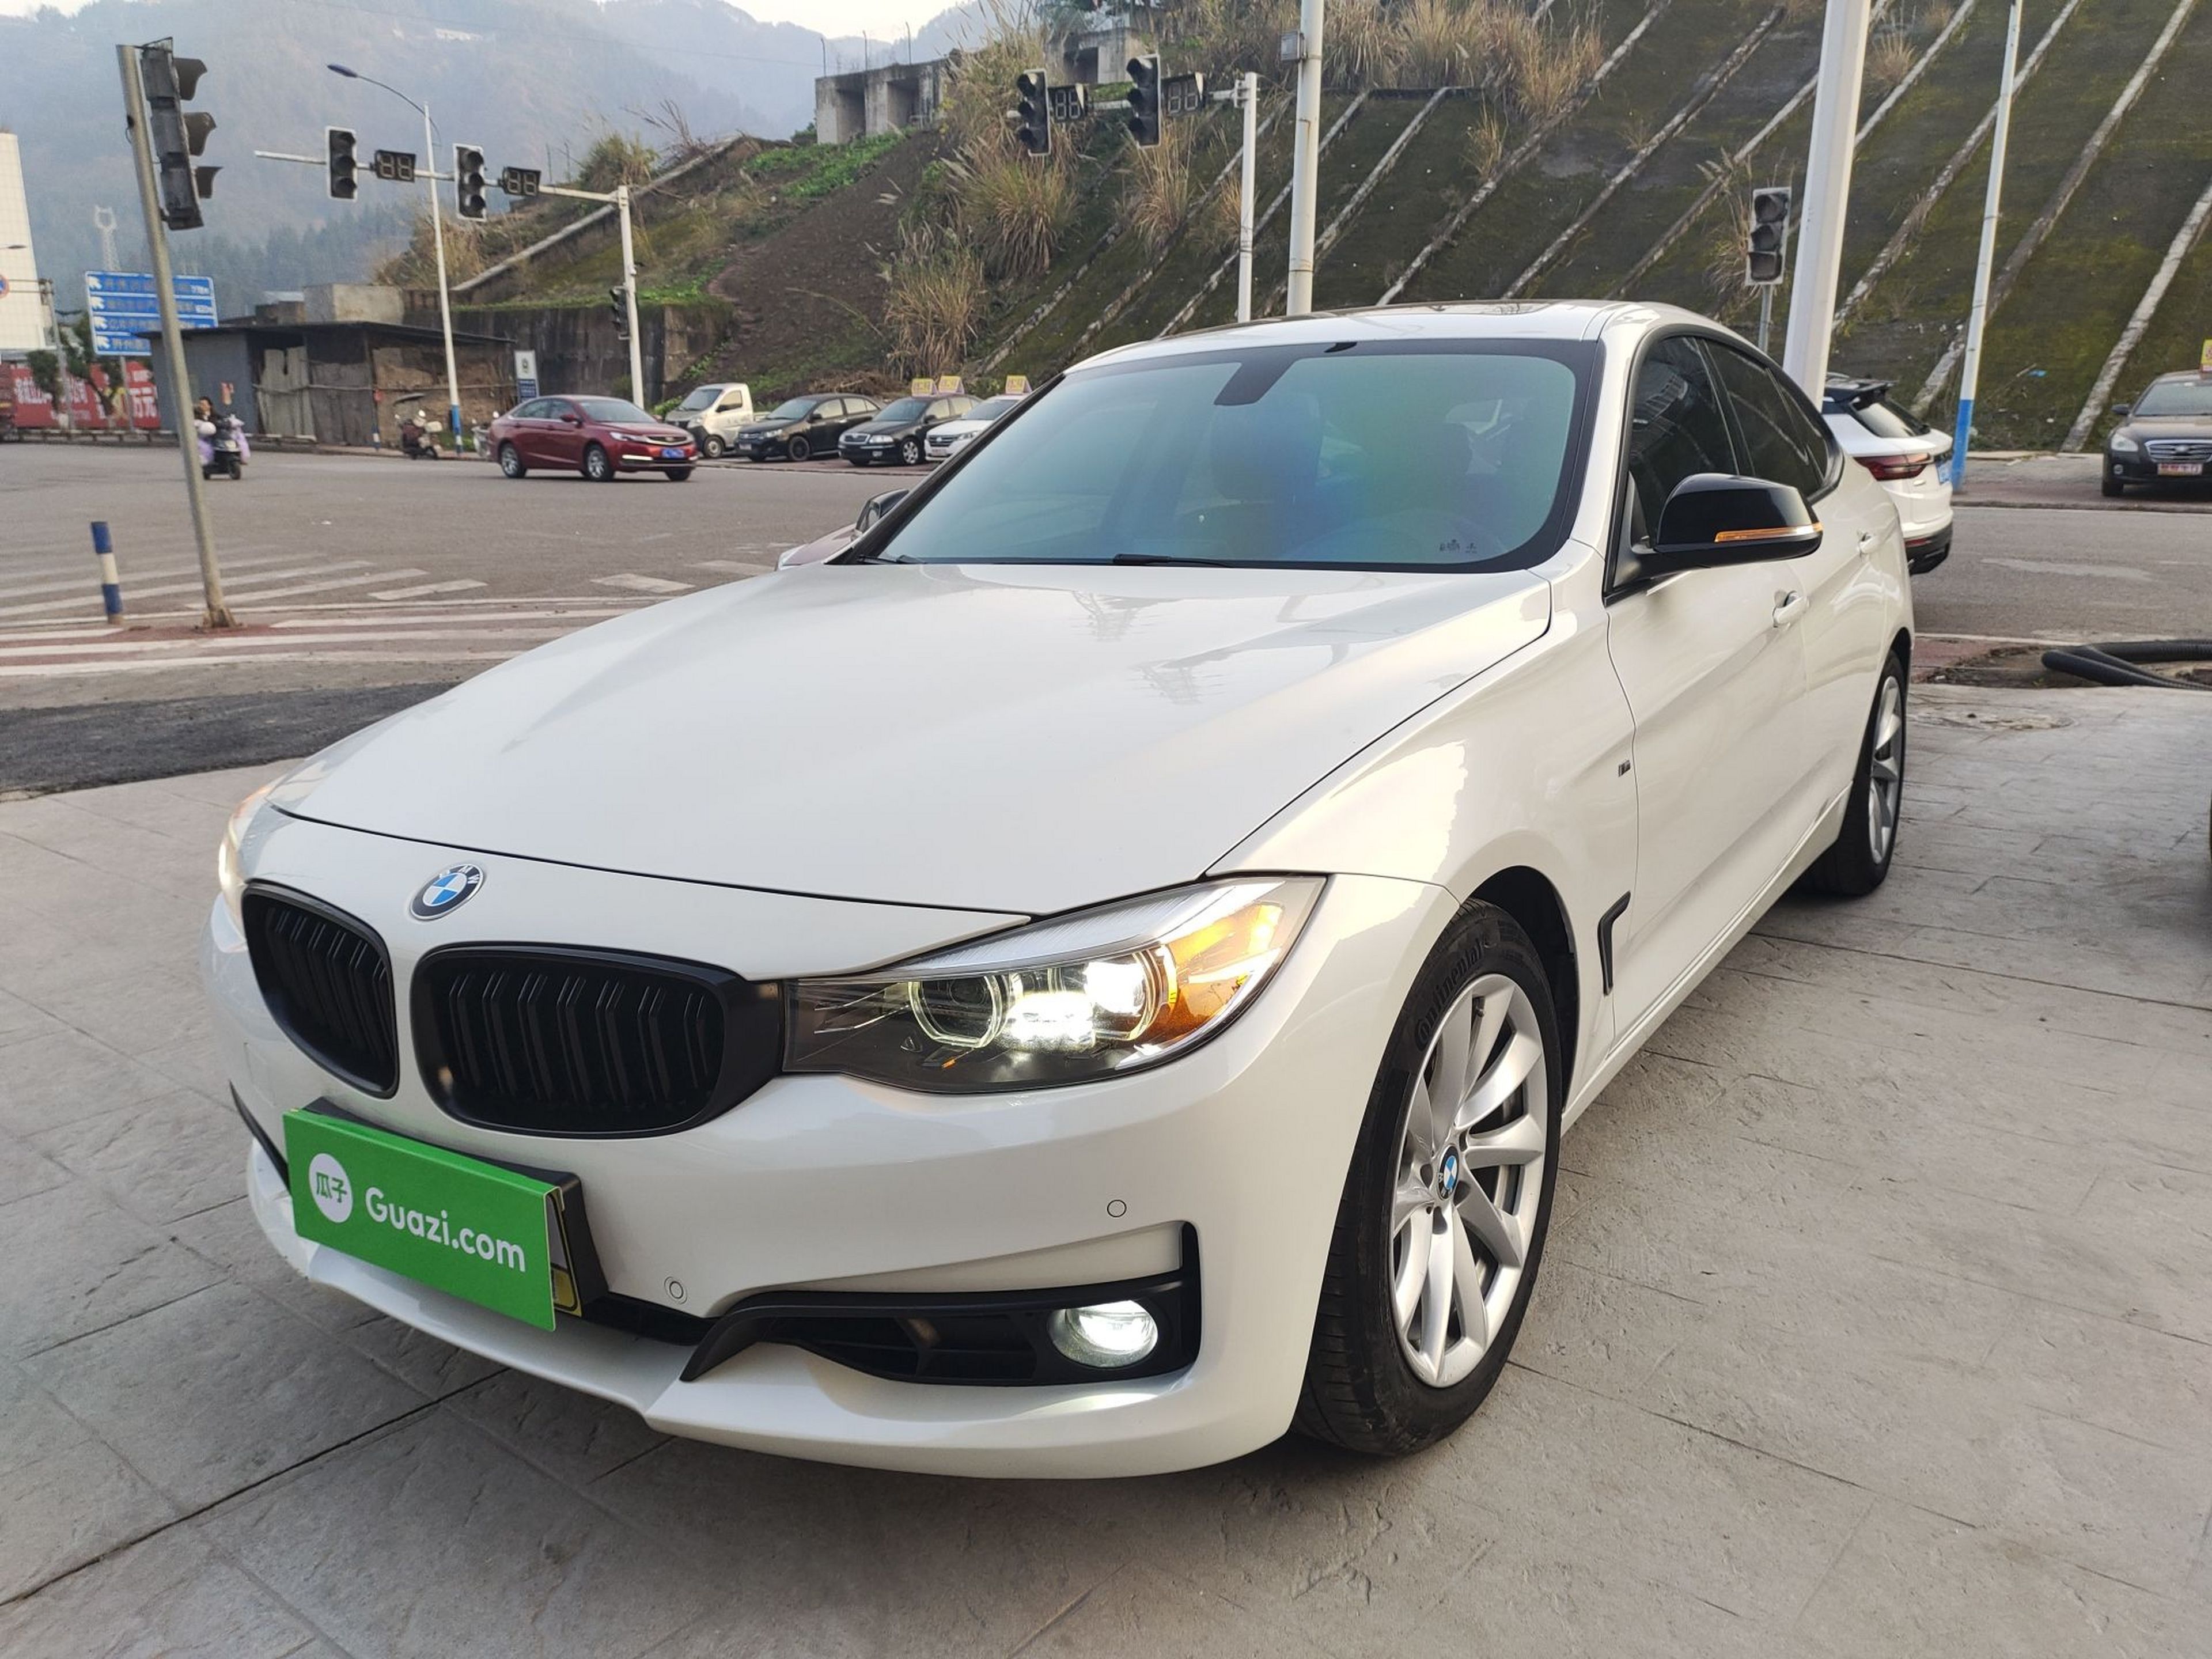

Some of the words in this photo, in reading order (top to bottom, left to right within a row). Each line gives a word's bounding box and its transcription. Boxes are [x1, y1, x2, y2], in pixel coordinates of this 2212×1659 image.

[1415, 937, 1483, 1051] Continental
[316, 1172, 347, 1203] 瓜子
[365, 1186, 527, 1272] Guazi.com
